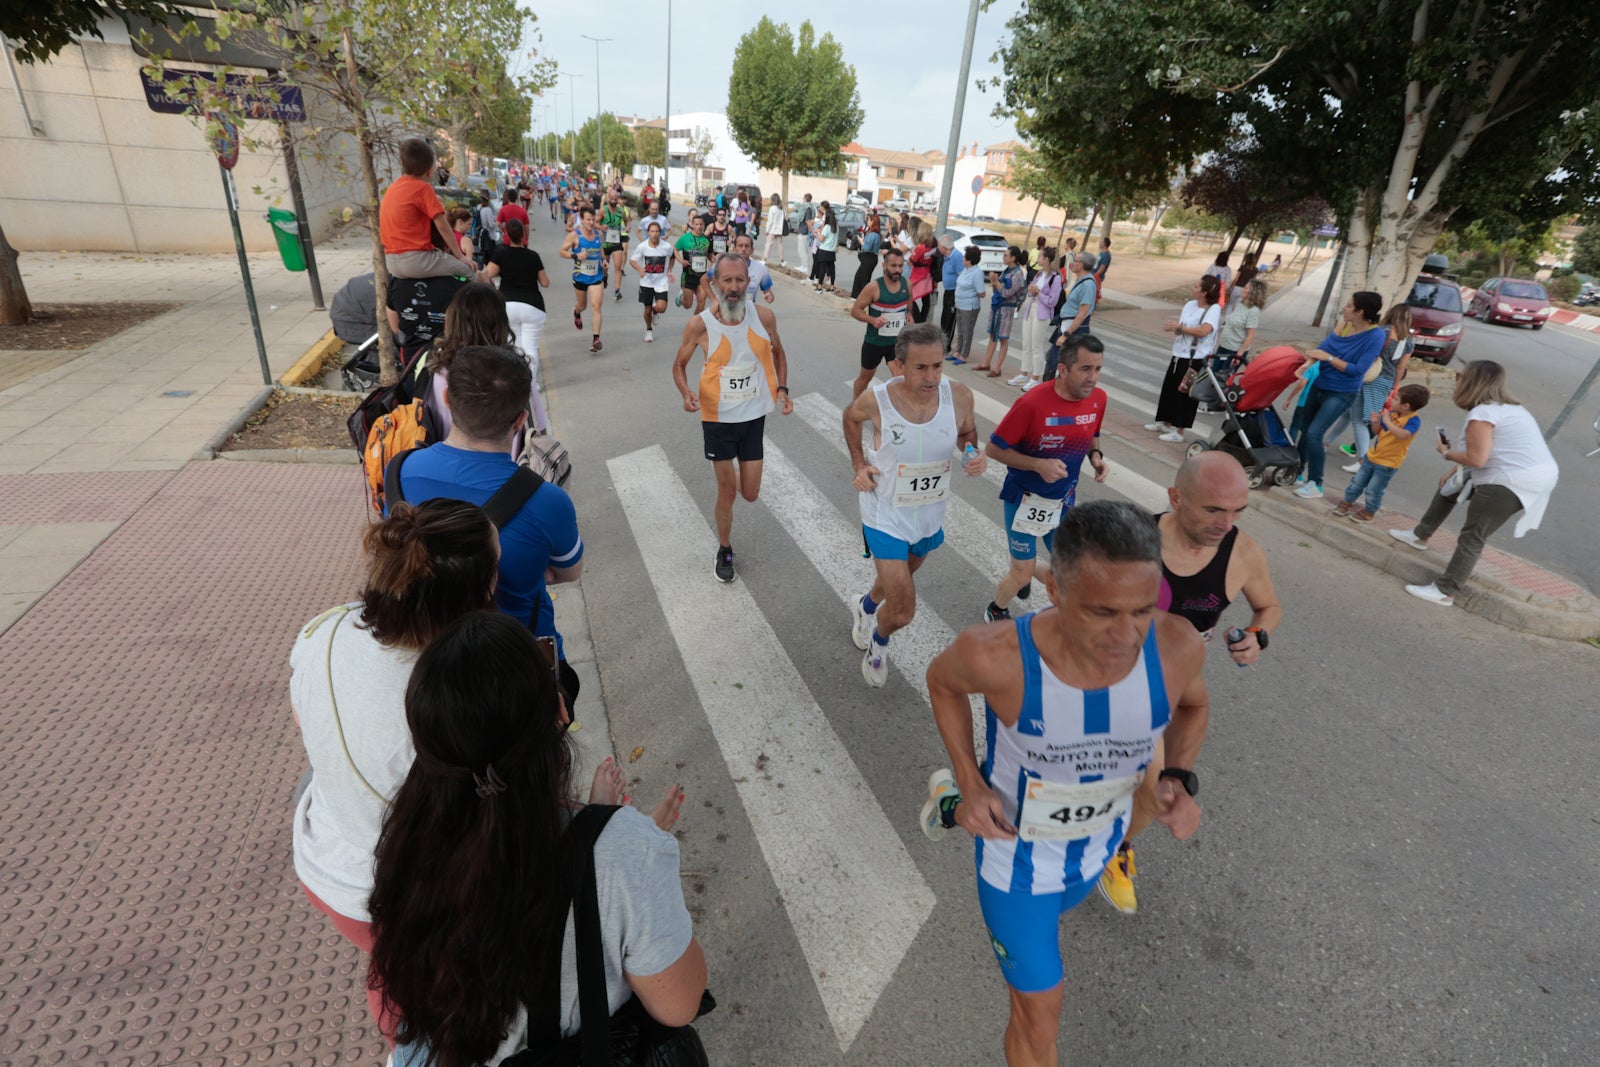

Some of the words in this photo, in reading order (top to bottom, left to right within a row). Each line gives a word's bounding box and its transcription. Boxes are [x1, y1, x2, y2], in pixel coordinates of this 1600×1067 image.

[729, 376, 751, 390] 577
[1075, 413, 1097, 425] SEUR
[910, 475, 942, 492] 137
[1027, 507, 1055, 523] 351
[1027, 750, 1088, 763] PAZITO
[1075, 761, 1118, 772] Motril
[1049, 799, 1114, 824] 494
